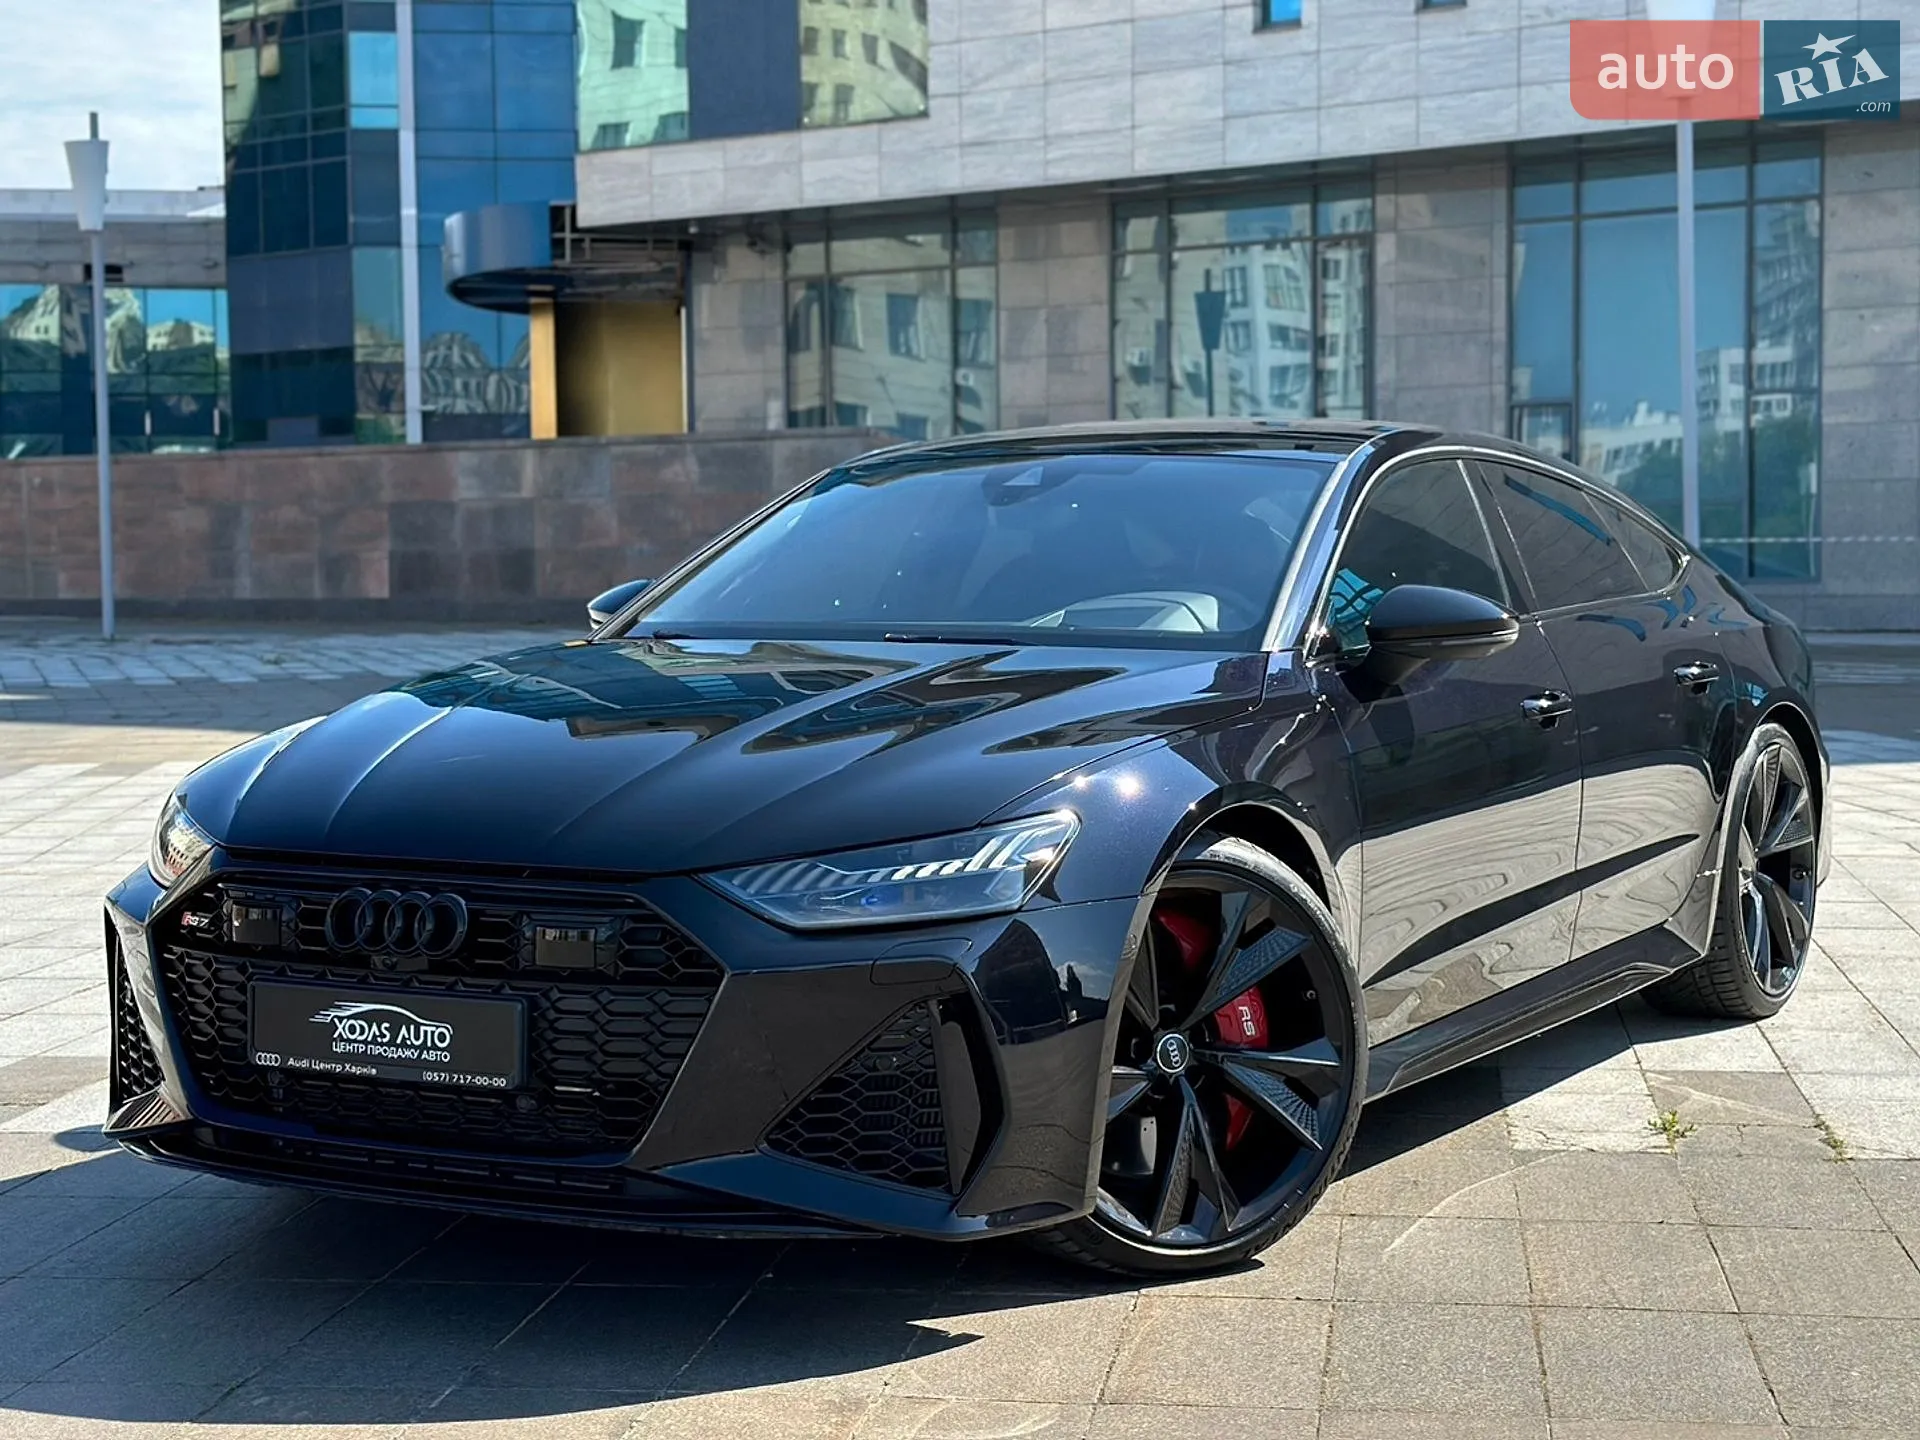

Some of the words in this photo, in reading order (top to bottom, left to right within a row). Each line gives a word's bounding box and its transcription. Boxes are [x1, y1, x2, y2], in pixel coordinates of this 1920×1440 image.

[1238, 1005, 1256, 1037] RS
[396, 1024, 451, 1048] AUTO
[332, 1041, 366, 1054] ЦЕНТР
[367, 1044, 420, 1059] ПРОДАЖУ
[421, 1049, 451, 1062] АВТО
[287, 1057, 310, 1068] Audi
[311, 1059, 342, 1072] Центр
[422, 1071, 450, 1082] (057)
[451, 1073, 507, 1087] 717-00-00
